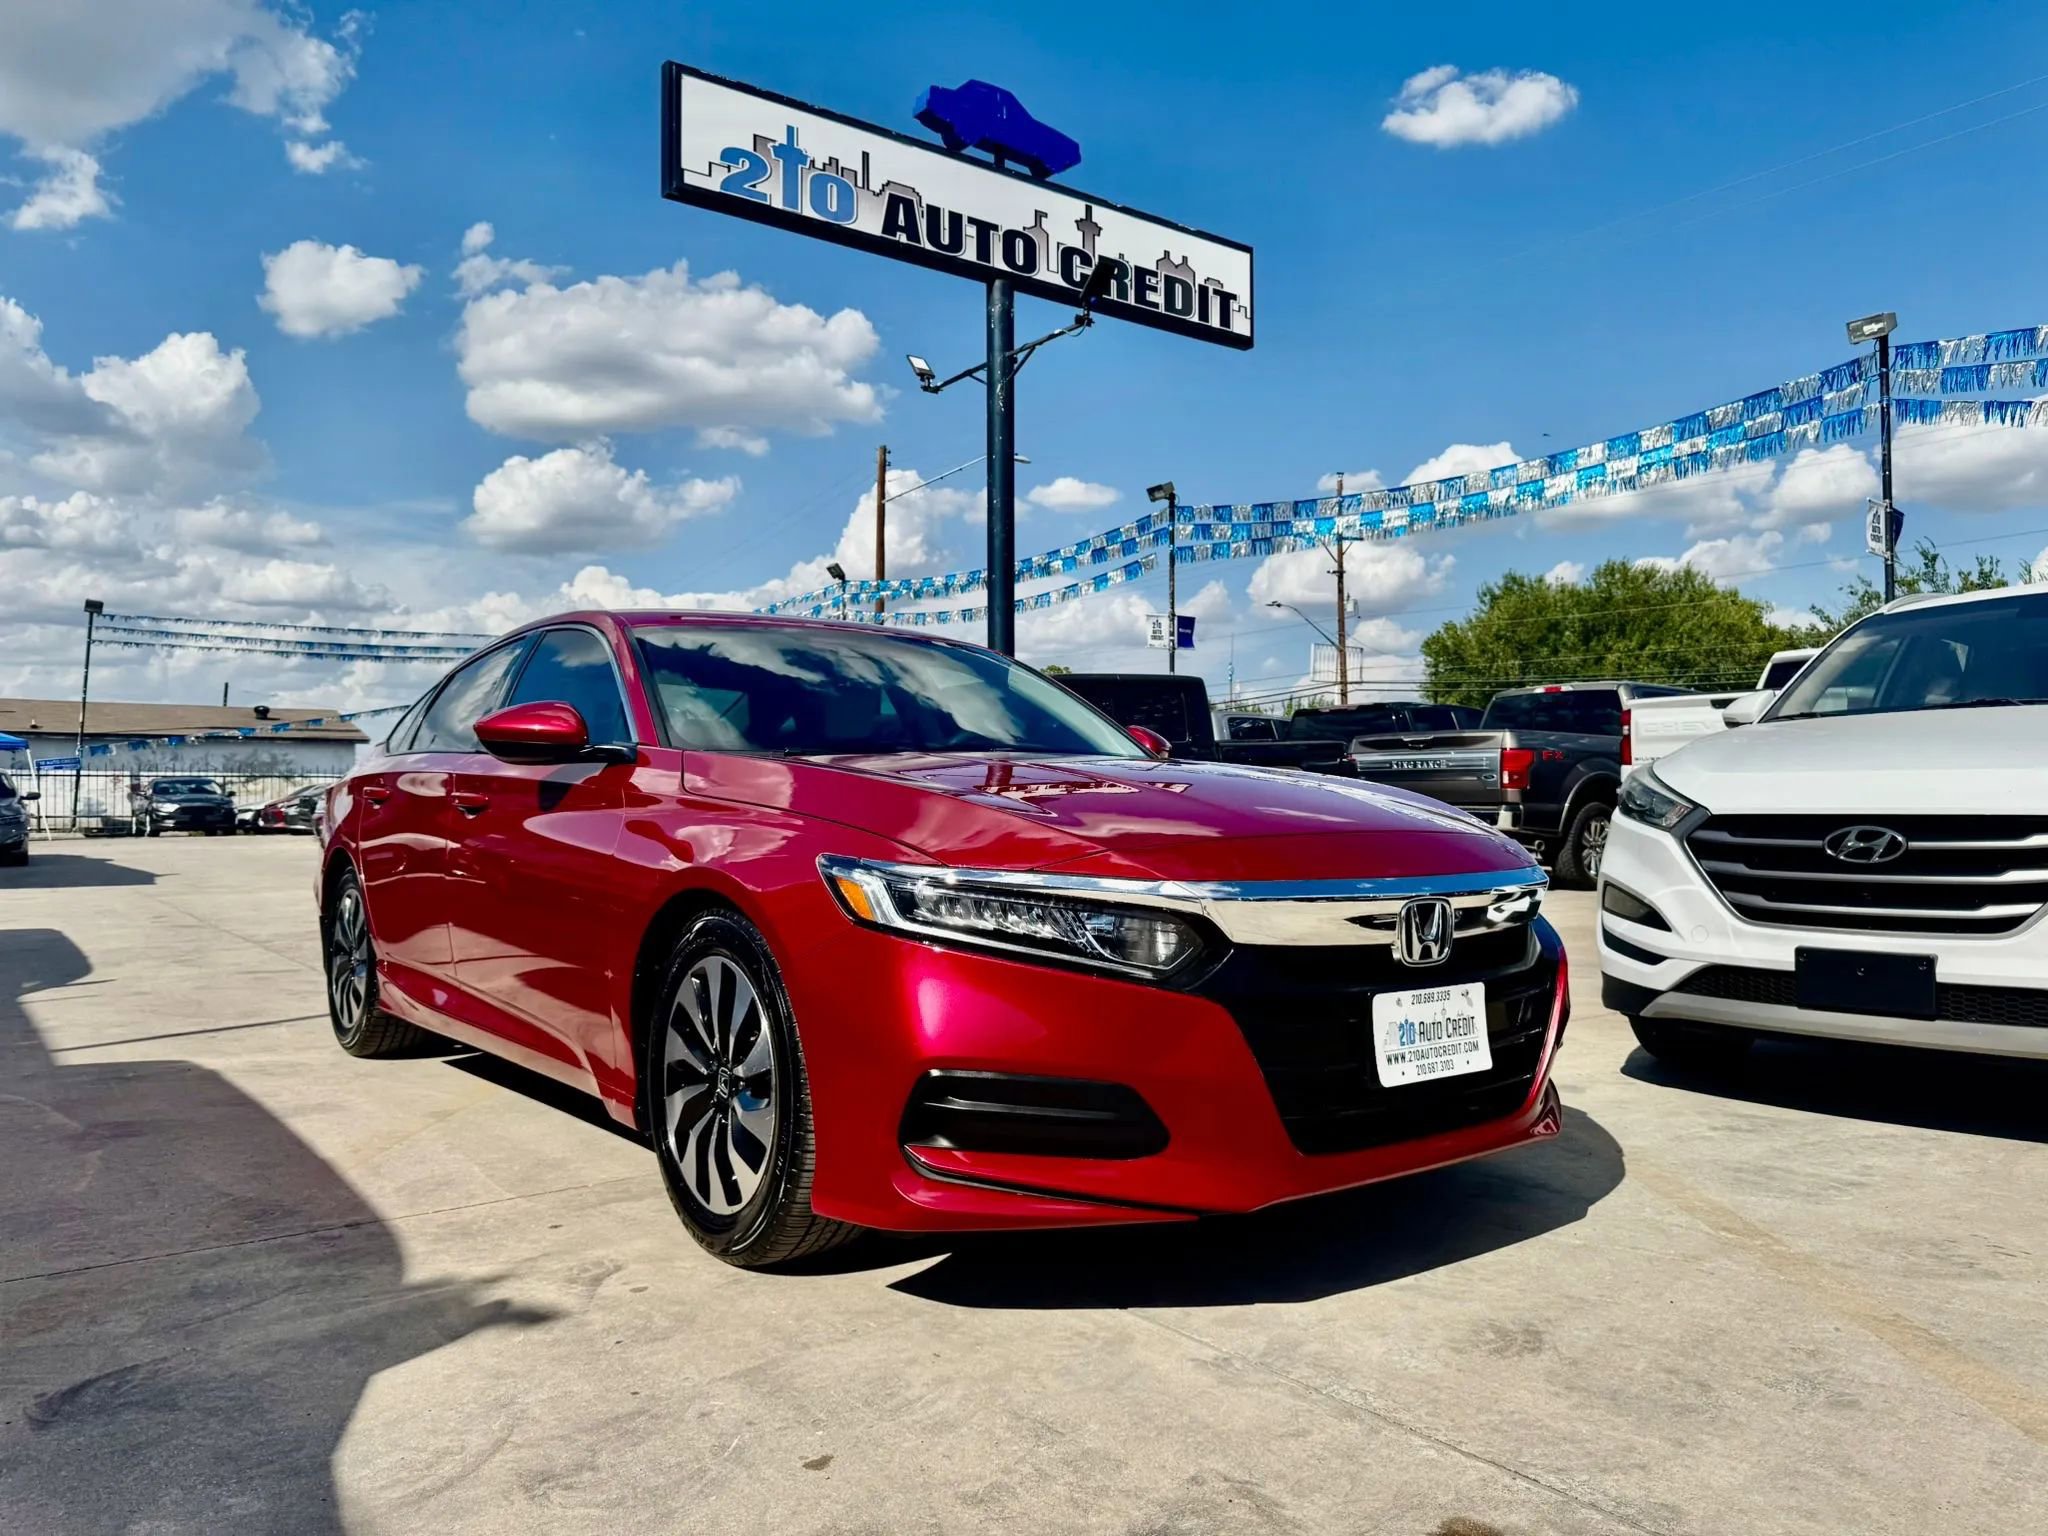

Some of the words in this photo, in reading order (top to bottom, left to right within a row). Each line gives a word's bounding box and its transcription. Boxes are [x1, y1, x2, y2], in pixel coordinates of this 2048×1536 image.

[719, 124, 858, 225] 210
[880, 191, 1041, 277] AUTO
[1060, 245, 1239, 331] CREDIT
[1391, 760, 1414, 769] KING
[1416, 759, 1447, 769] RANCH
[1411, 990, 1451, 1005] 210.689.3335
[1398, 1017, 1416, 1047] 210
[1415, 1059, 1455, 1076] 210.687.3103
